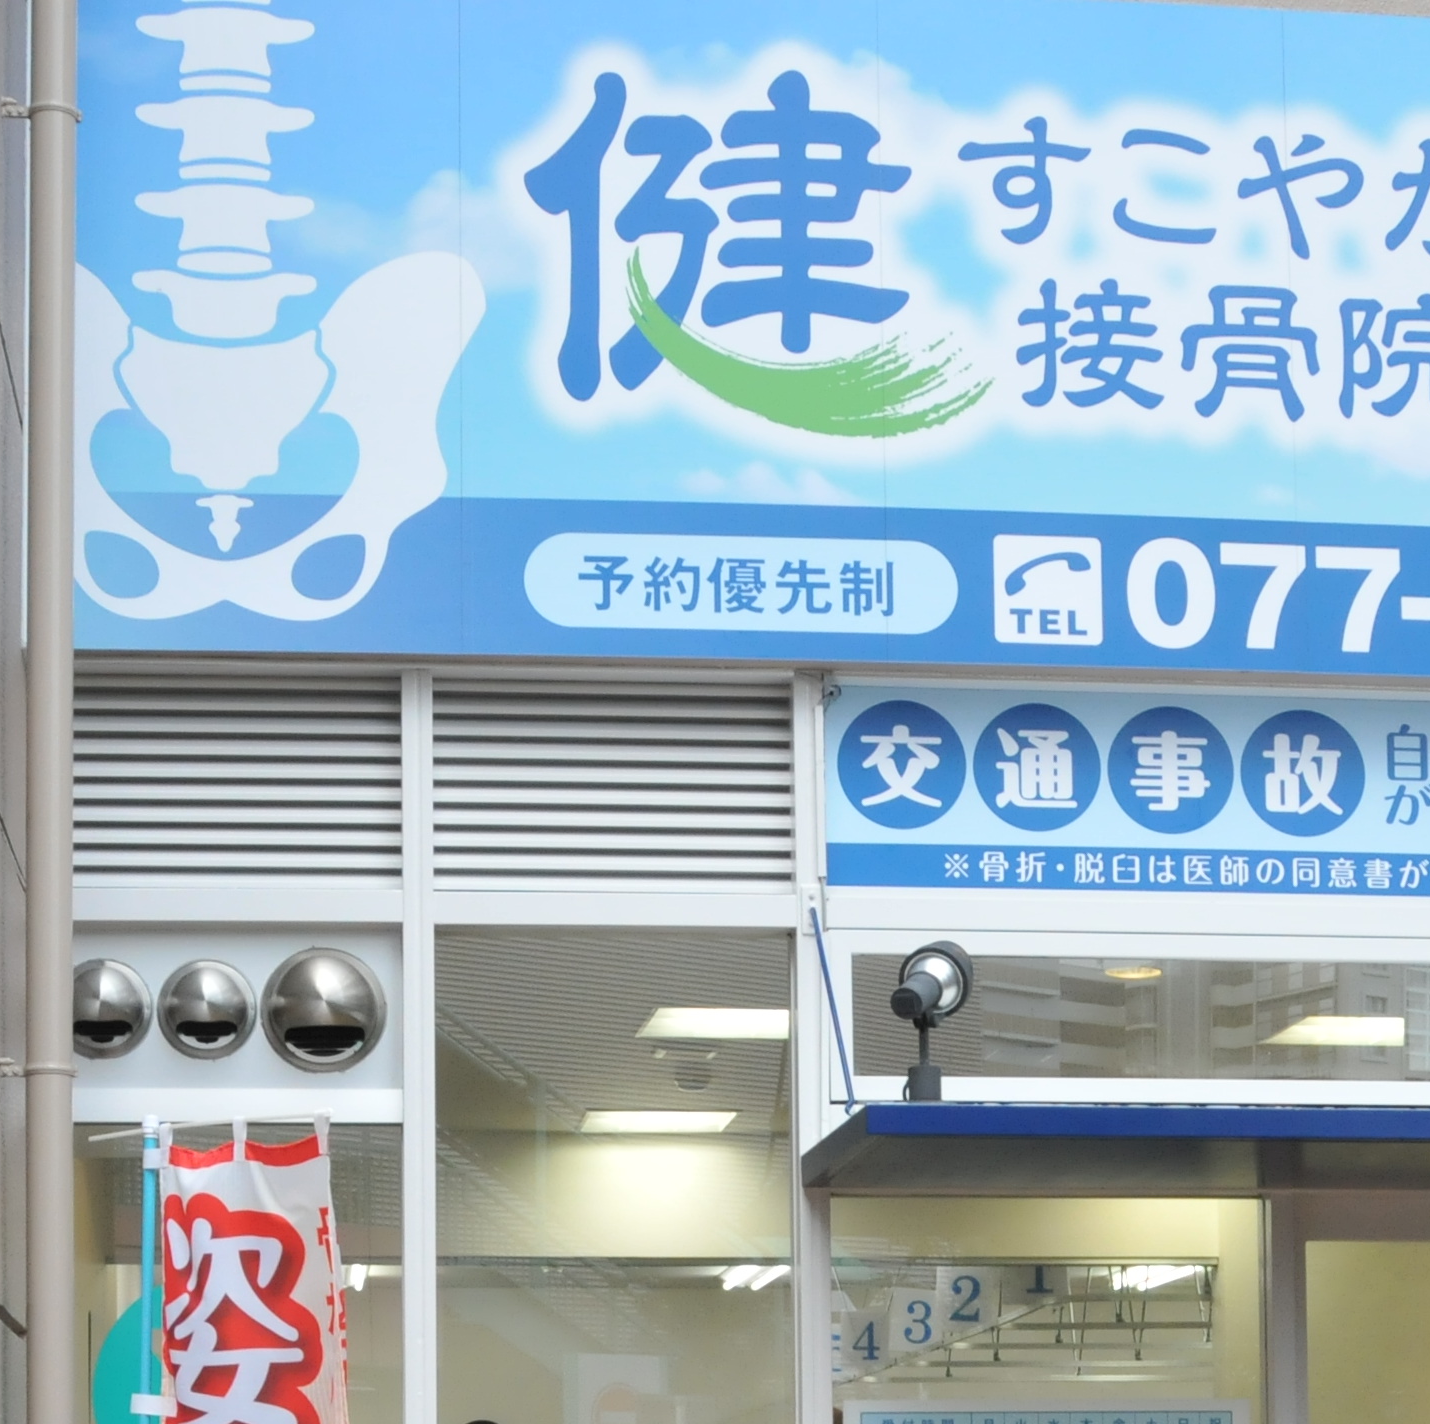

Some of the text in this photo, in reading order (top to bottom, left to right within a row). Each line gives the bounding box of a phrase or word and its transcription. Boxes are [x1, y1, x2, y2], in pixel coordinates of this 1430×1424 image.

[524, 70, 912, 402] 健
[577, 553, 895, 618] 予約優先制
[1009, 607, 1089, 637] TEL
[859, 723, 1345, 818] 交通事故
[904, 1300, 933, 1344] 3
[949, 1275, 982, 1323] 2
[852, 1320, 881, 1361] 4
